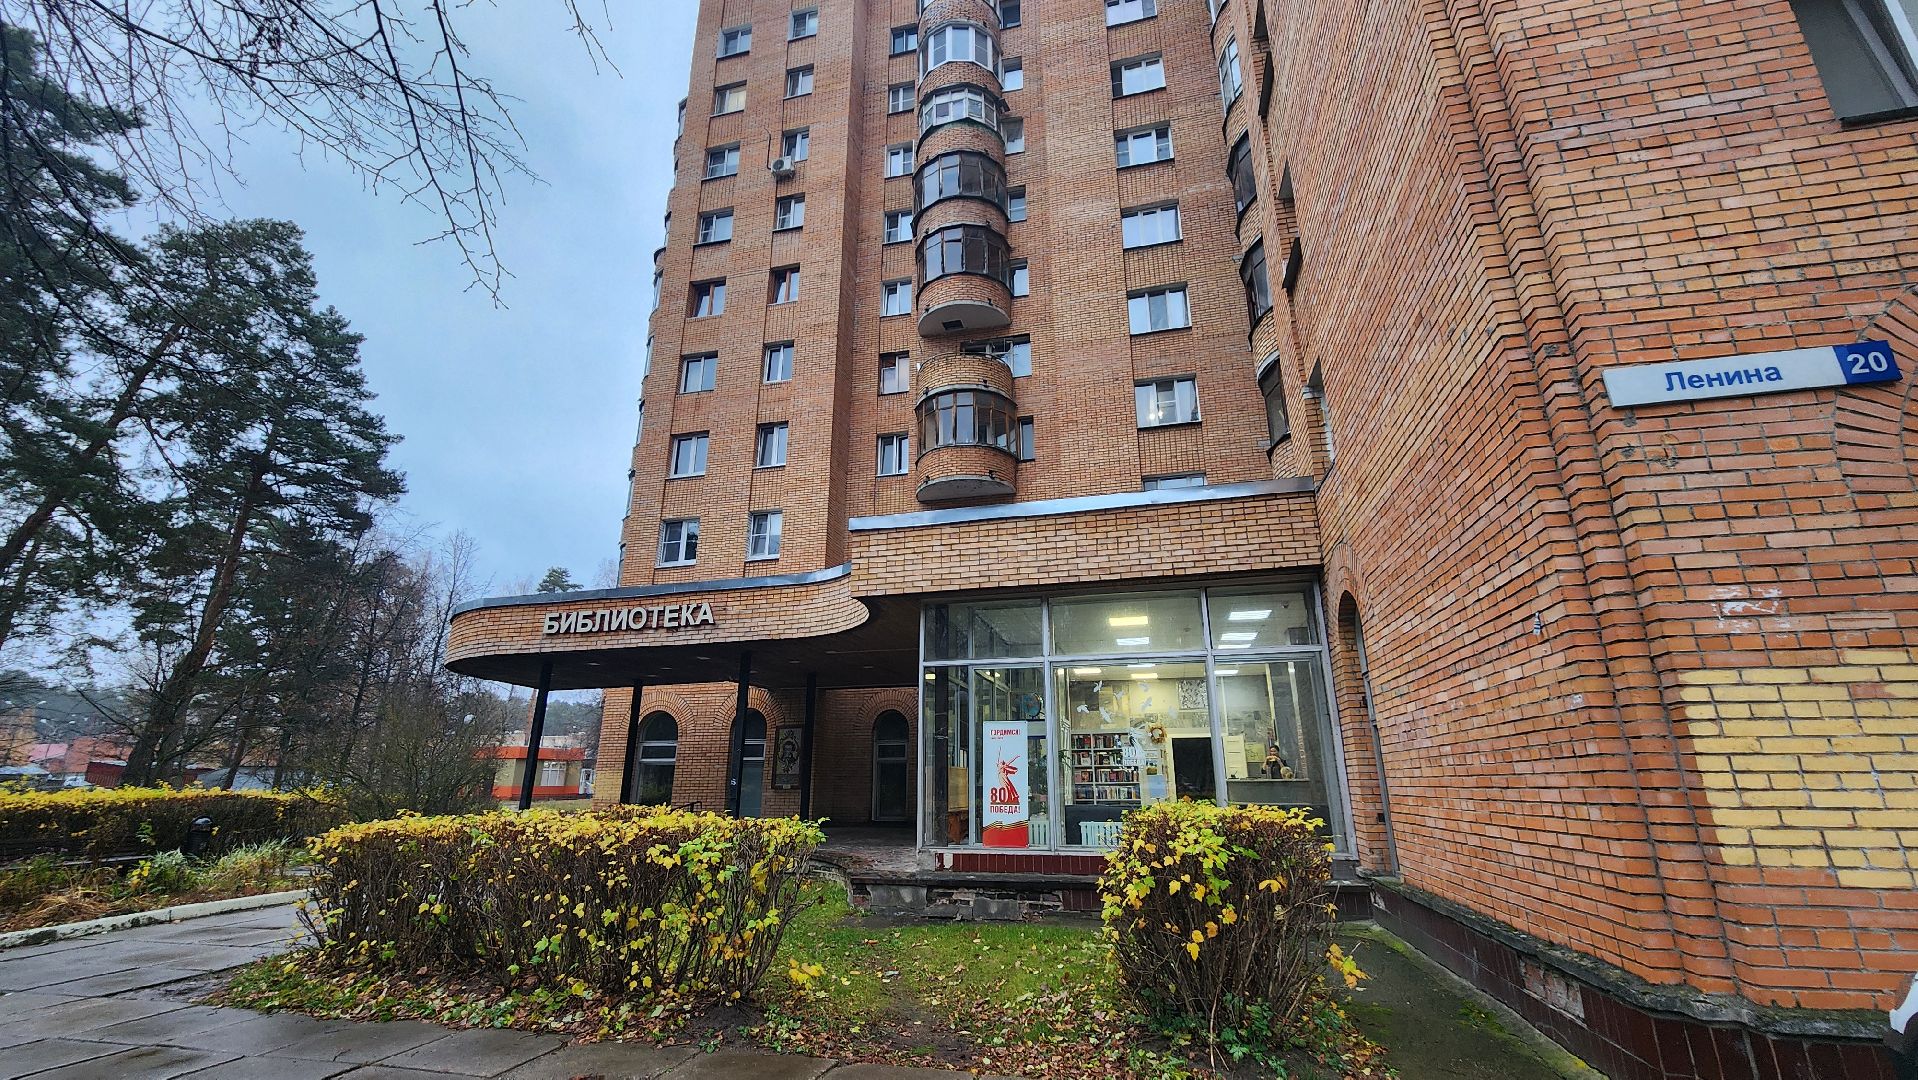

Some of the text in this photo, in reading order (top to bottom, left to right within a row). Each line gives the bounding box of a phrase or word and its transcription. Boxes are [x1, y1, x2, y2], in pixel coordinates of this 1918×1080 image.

[1665, 351, 1888, 392] Ленина 20
[543, 603, 714, 634] БИБЛИОТЕКА
[990, 805, 1020, 814] ПОБЕДА!
